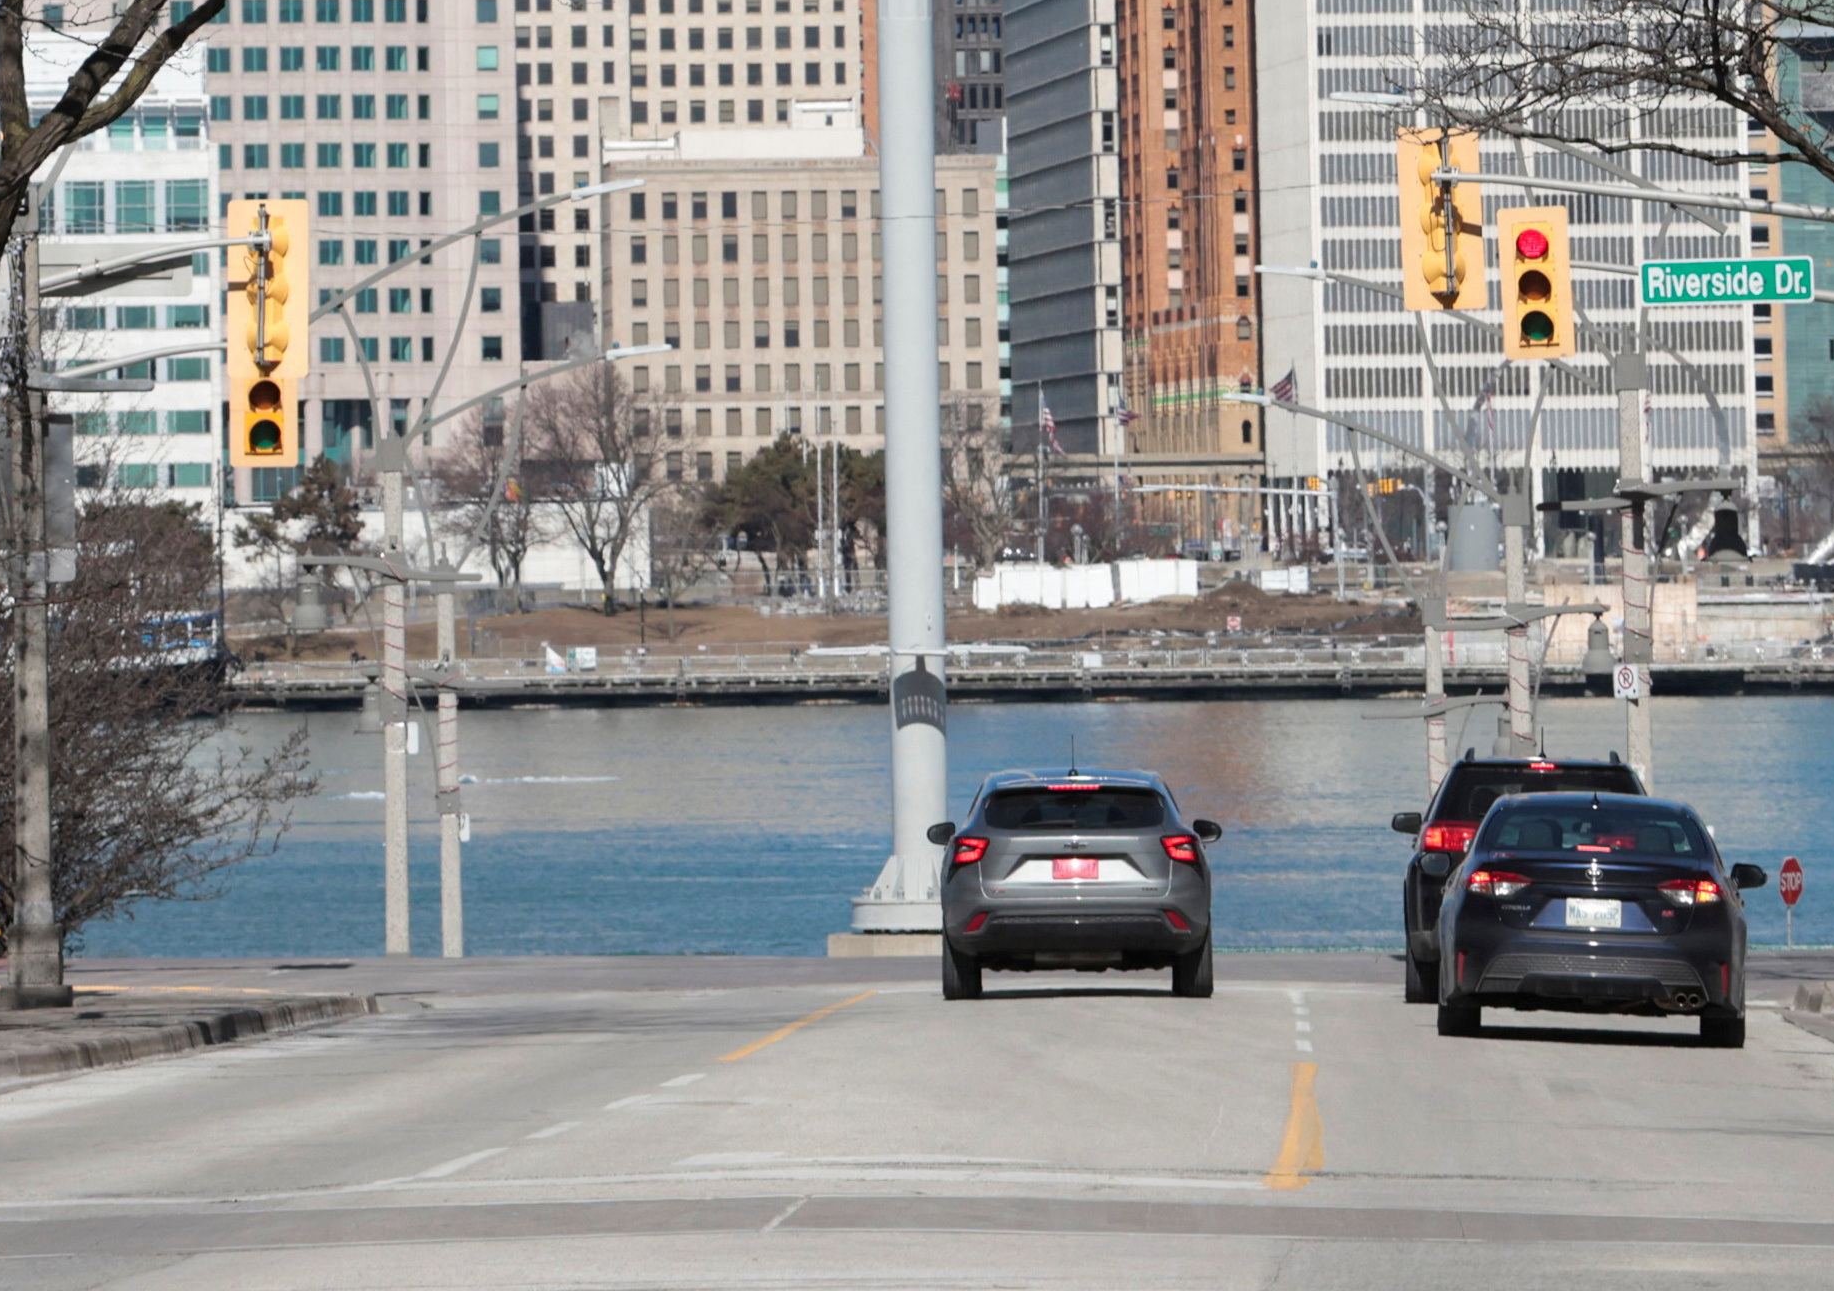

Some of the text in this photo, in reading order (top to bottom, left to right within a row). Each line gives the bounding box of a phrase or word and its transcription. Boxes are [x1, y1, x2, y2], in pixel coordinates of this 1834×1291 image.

[1646, 262, 1808, 299] Riverside Dr.
[1780, 871, 1802, 892] STOP
